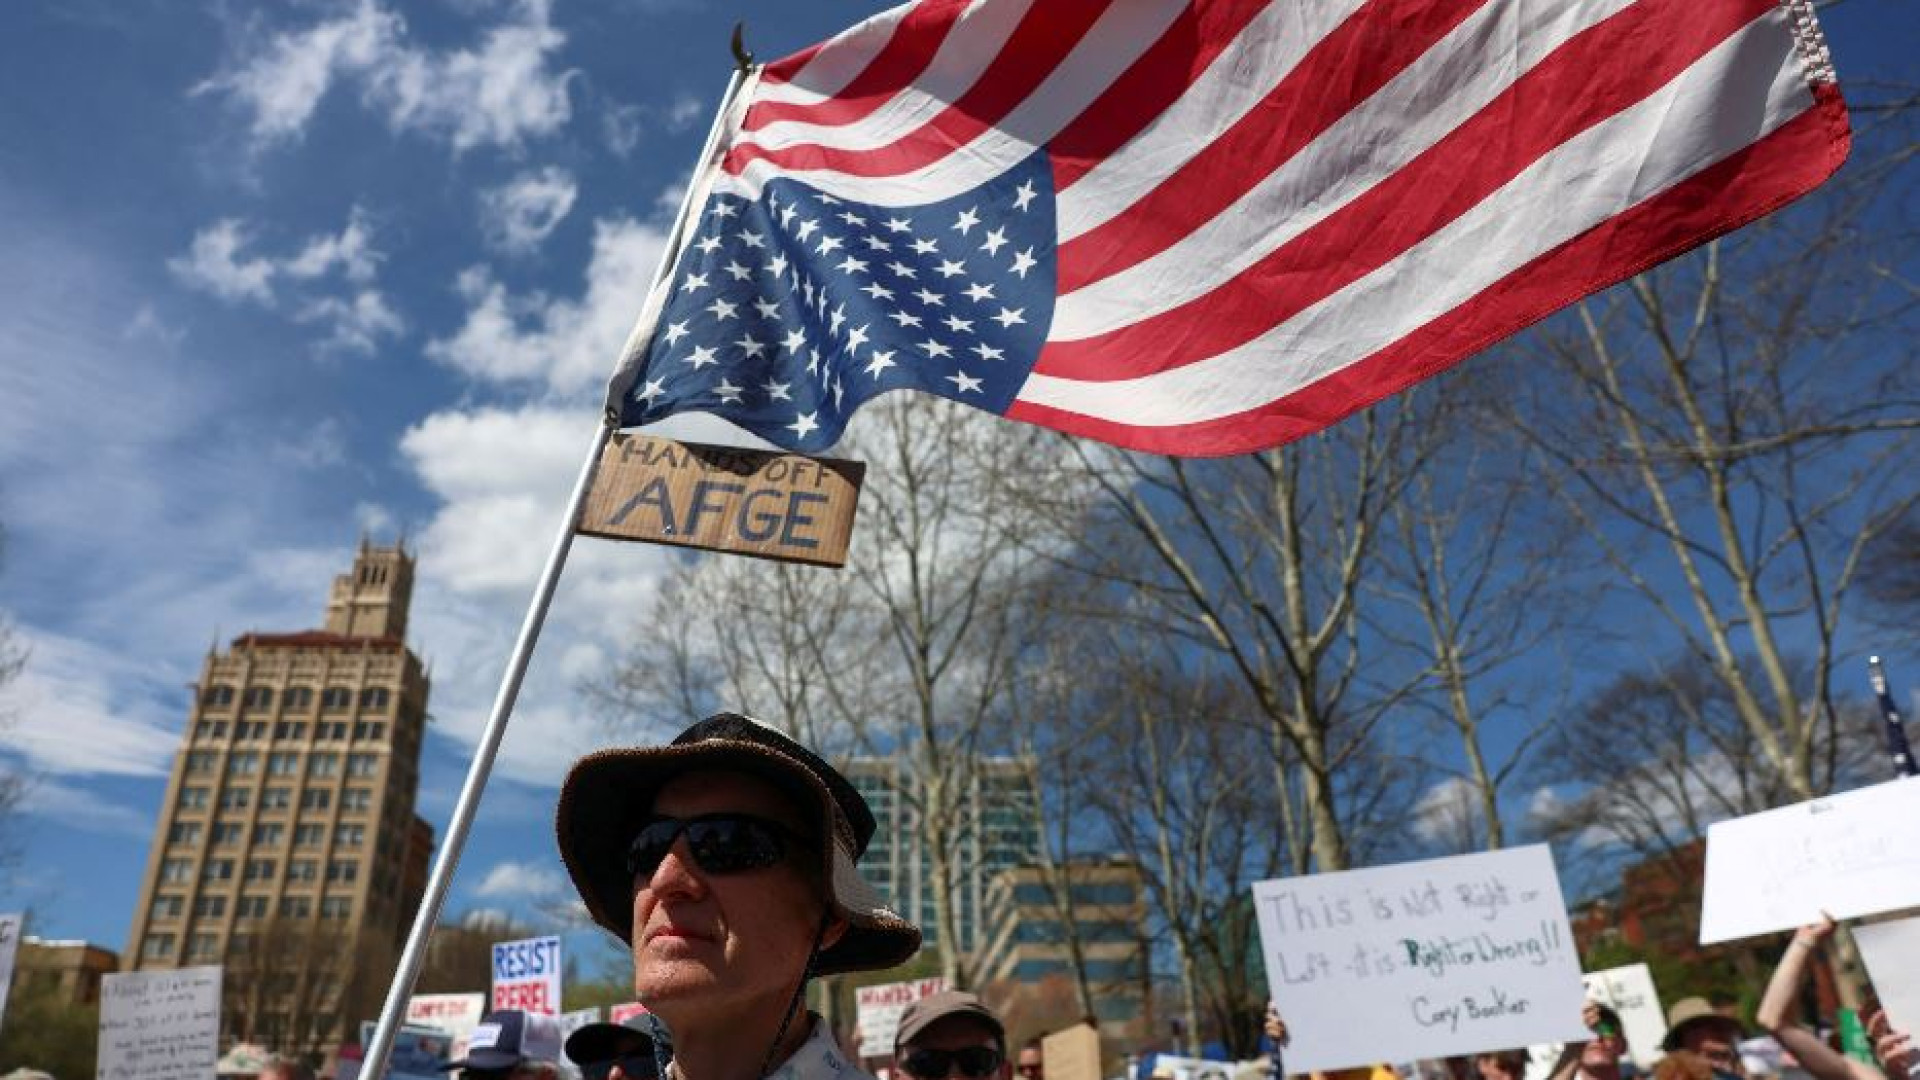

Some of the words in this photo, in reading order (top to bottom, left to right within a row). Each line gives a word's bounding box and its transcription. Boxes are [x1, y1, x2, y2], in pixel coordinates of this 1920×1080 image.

[764, 457, 830, 488] OFF
[606, 476, 829, 548] AFGE
[1263, 889, 1353, 933] This
[1363, 887, 1394, 920] is
[1453, 875, 1509, 921] Right
[494, 940, 558, 979] RESIST
[1413, 994, 1459, 1034] Cory
